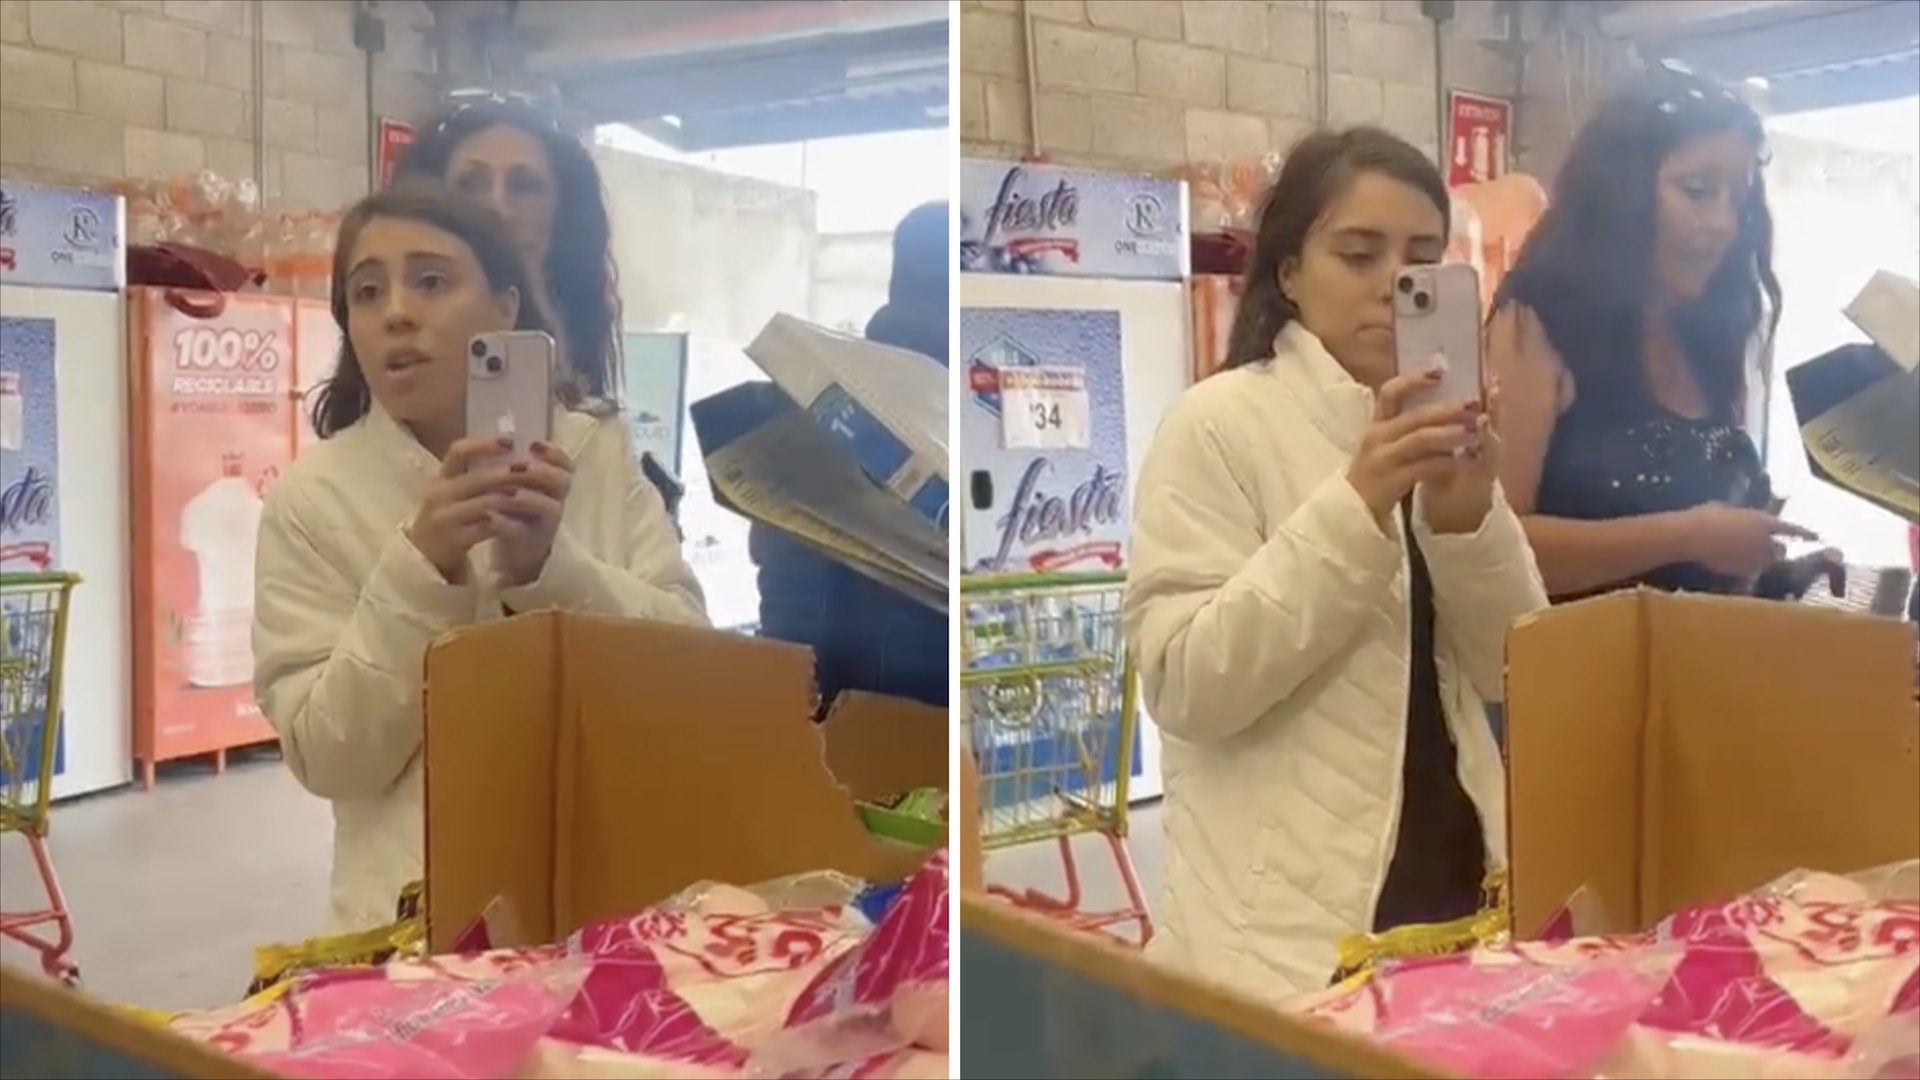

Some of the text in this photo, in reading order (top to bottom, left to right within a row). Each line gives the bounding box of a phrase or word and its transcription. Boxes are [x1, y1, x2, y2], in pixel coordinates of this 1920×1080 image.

[983, 166, 1080, 243] fiesta
[173, 328, 279, 371] 100%
[994, 456, 1123, 570] fiesta
